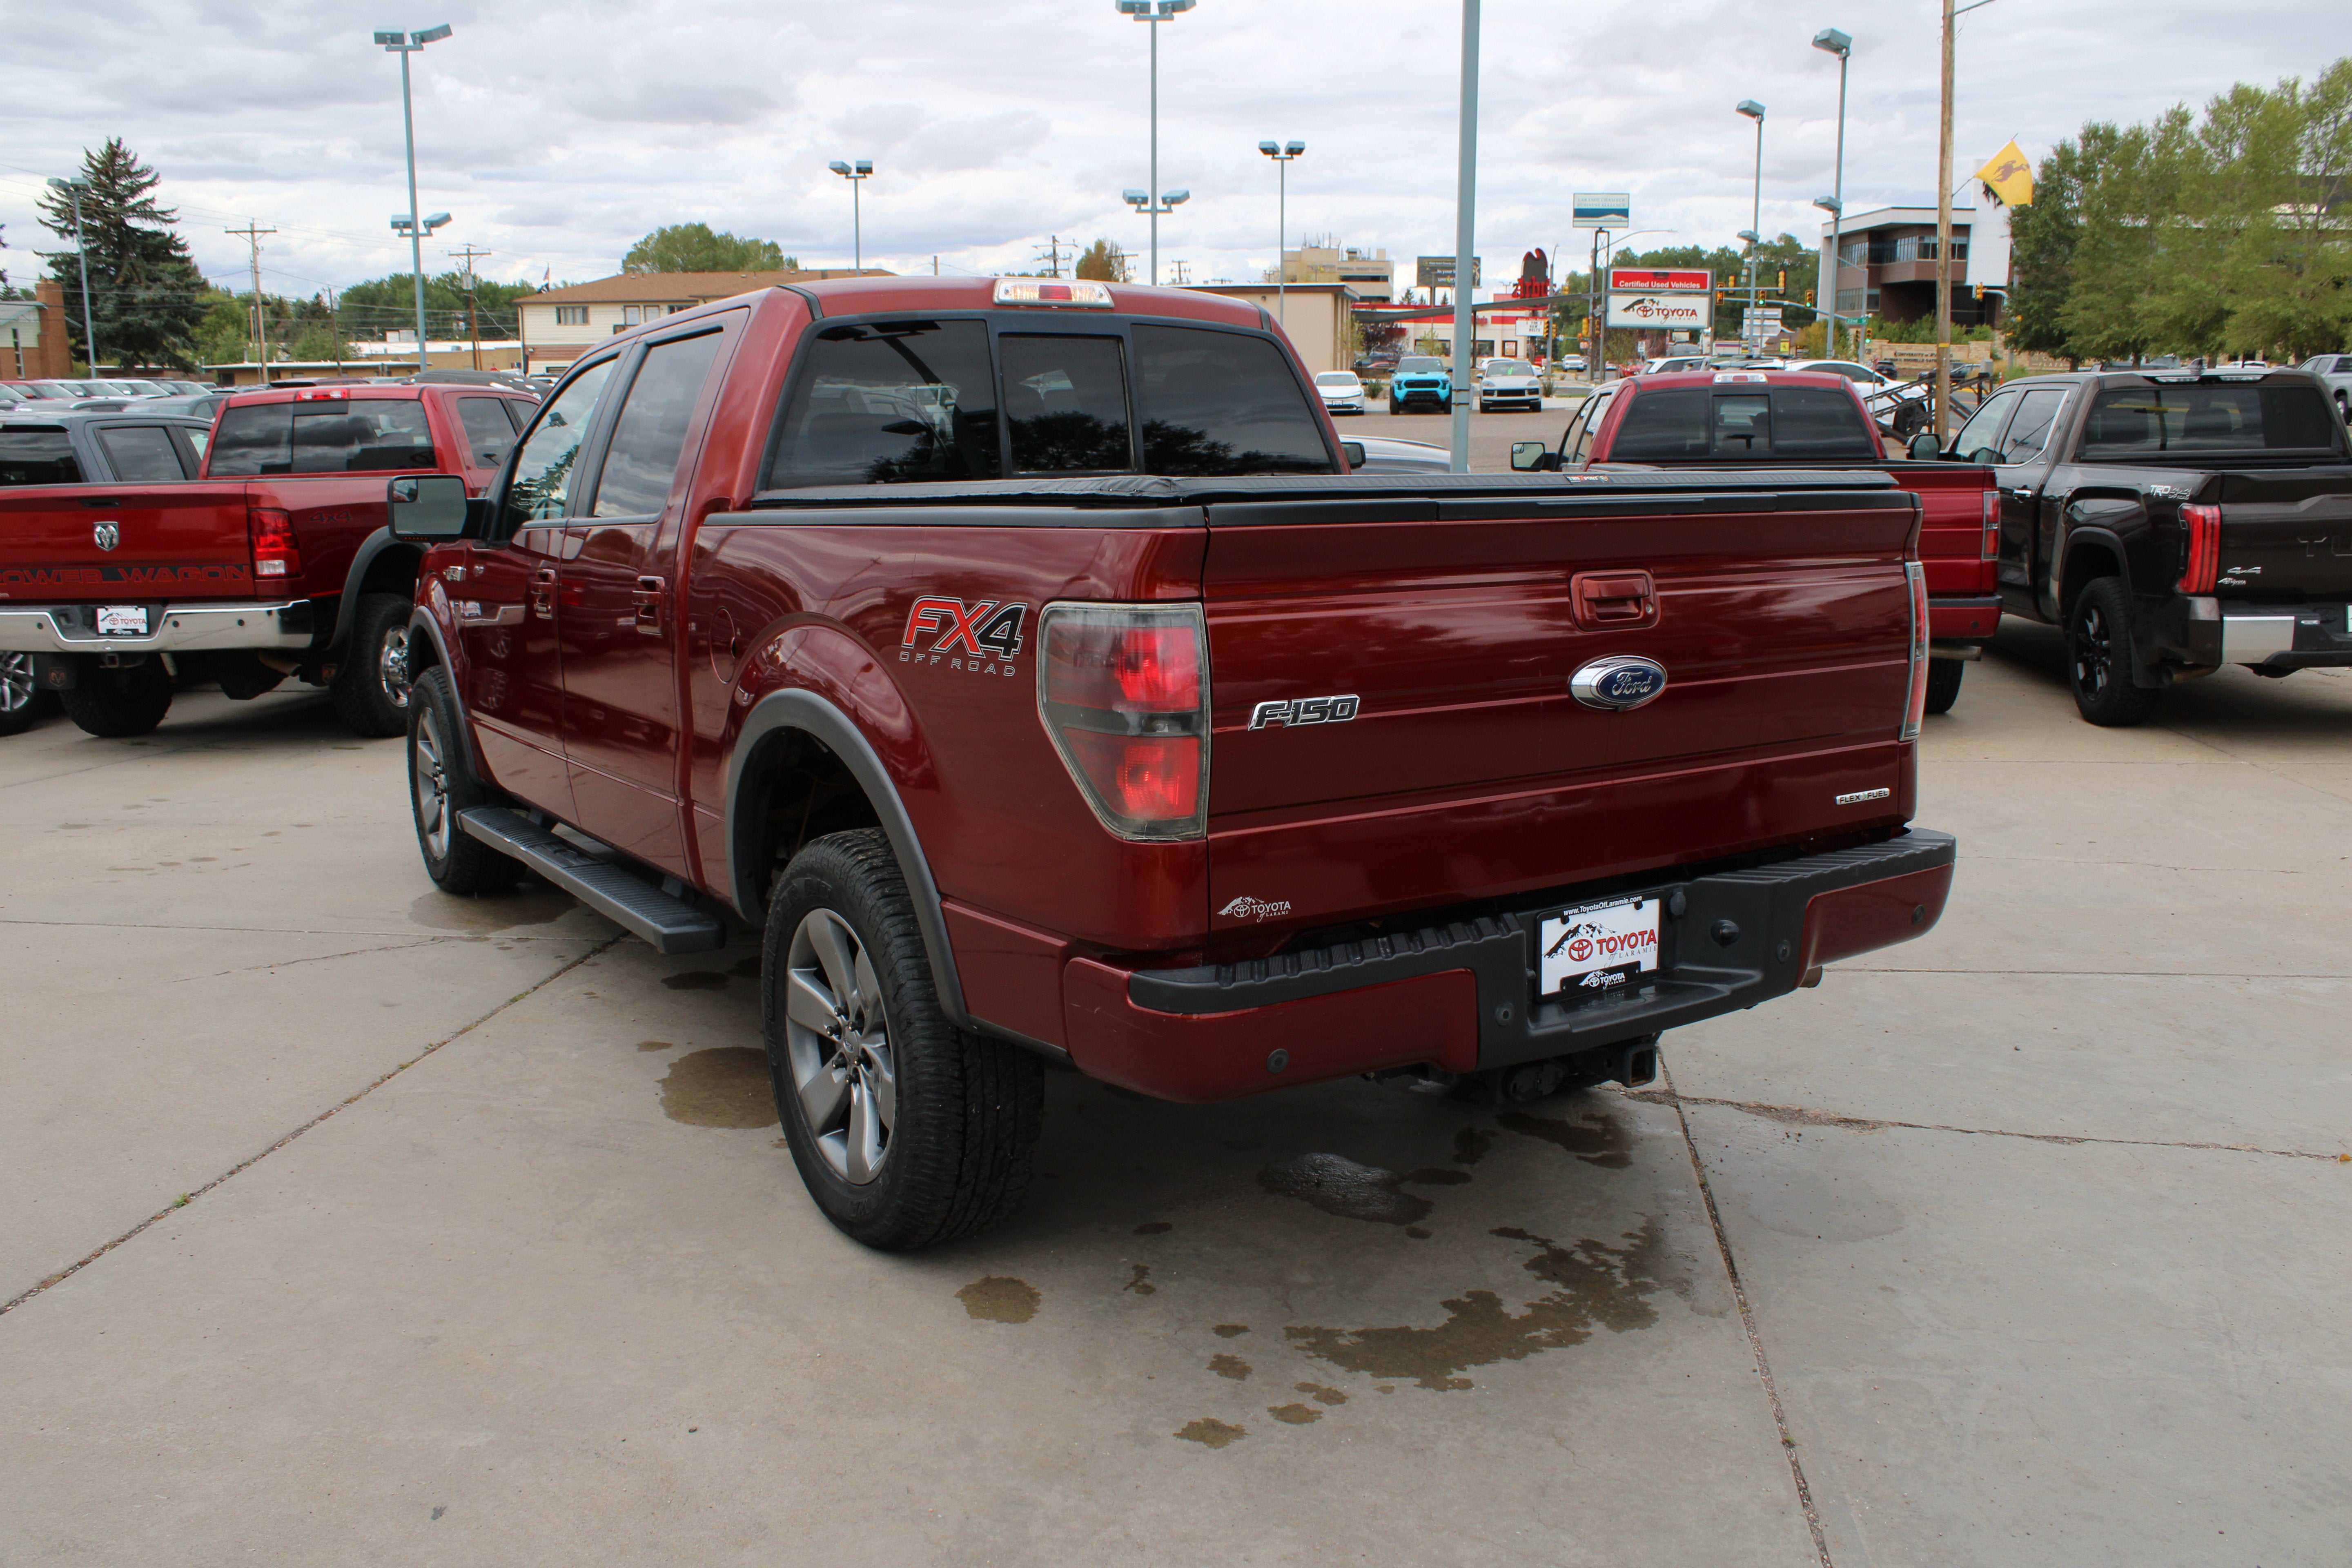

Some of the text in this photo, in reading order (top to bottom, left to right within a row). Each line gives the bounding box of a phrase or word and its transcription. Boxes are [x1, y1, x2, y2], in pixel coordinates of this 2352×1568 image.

[1656, 308, 1697, 317] TOYOTA
[2150, 485, 2171, 497] TRD
[118, 565, 252, 583] WAGON
[901, 595, 1028, 662] FX4
[899, 651, 1016, 677] OFF ROAD
[1612, 671, 1653, 695] Ford
[1248, 694, 1361, 731] F-150
[1840, 791, 1888, 804] FLEX FUEL
[1251, 901, 1291, 914] TOYOTA
[1564, 895, 1642, 916] www.ToyotaOfLaramie.com
[1596, 929, 1657, 955] TOYOTA
[1619, 945, 1657, 958] LARAMIE
[1600, 972, 1625, 984] TOYOTA
